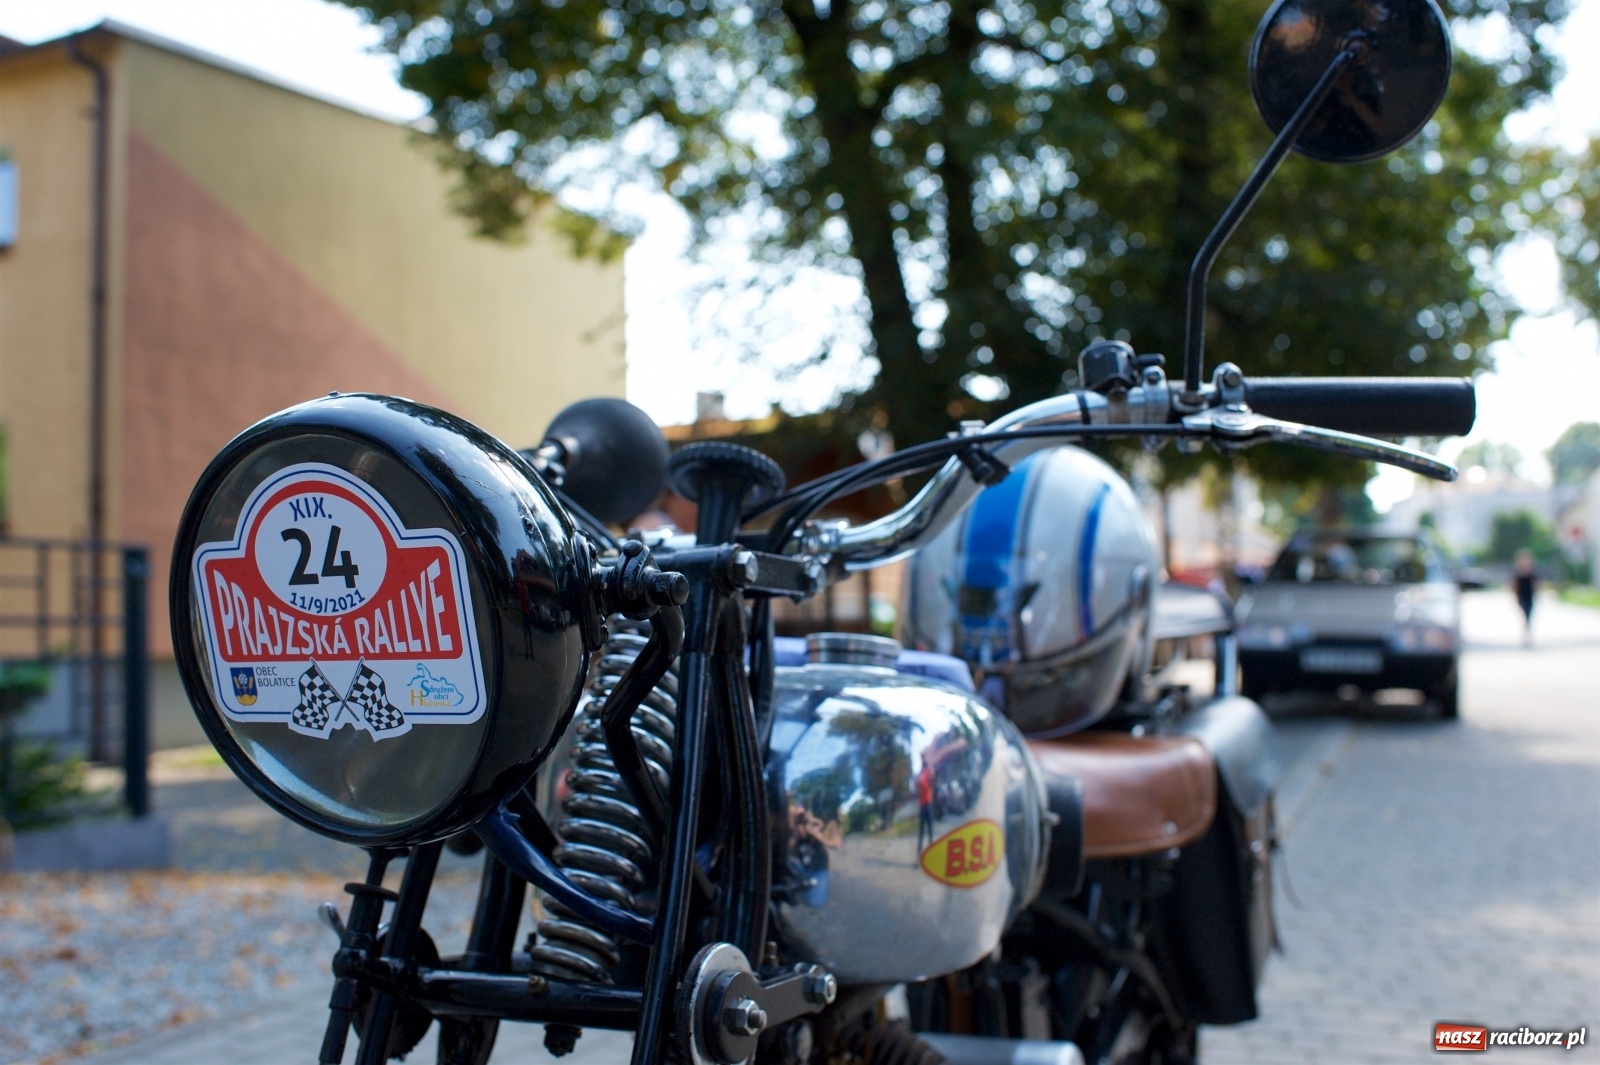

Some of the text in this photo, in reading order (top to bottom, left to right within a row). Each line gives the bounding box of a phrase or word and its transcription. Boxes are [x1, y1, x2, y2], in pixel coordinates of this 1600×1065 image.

[289, 497, 333, 522] XIX.
[280, 525, 360, 589] 24
[213, 558, 453, 656] PRAJZSKÁ RALLYE
[290, 589, 366, 614] 11/9/2021
[255, 666, 278, 676] OBEC
[257, 677, 296, 688] BOLATICE
